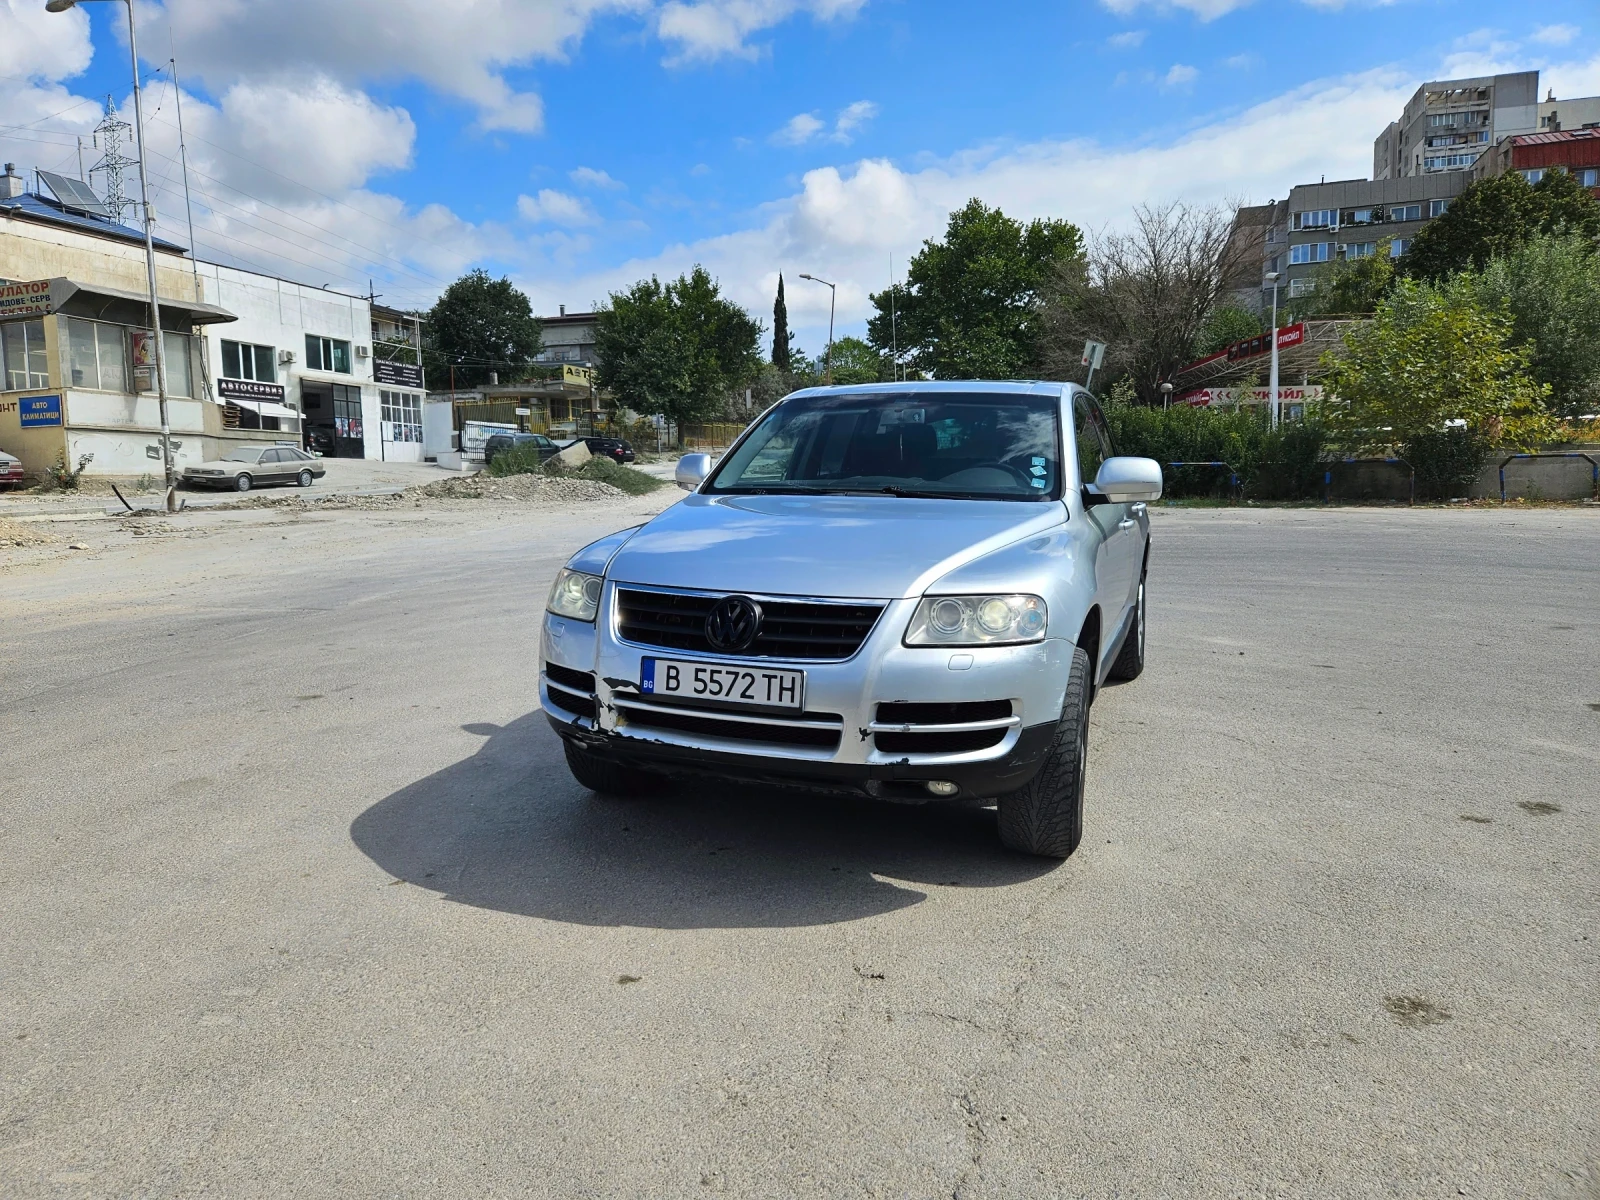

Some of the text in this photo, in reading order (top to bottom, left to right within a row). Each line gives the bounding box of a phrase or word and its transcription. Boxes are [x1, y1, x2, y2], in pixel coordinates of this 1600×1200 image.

[0, 281, 51, 298] УЛАТОР
[1278, 330, 1300, 345] ЛУКОЙЛ
[221, 381, 283, 395] АВТОСЕРВИЗ
[1243, 387, 1305, 401] УКЙЛ
[32, 401, 48, 409] АВТО
[22, 411, 60, 421] КЛИМАТИЦИ
[643, 679, 654, 689] BG
[665, 665, 796, 703] B 5572 TH
